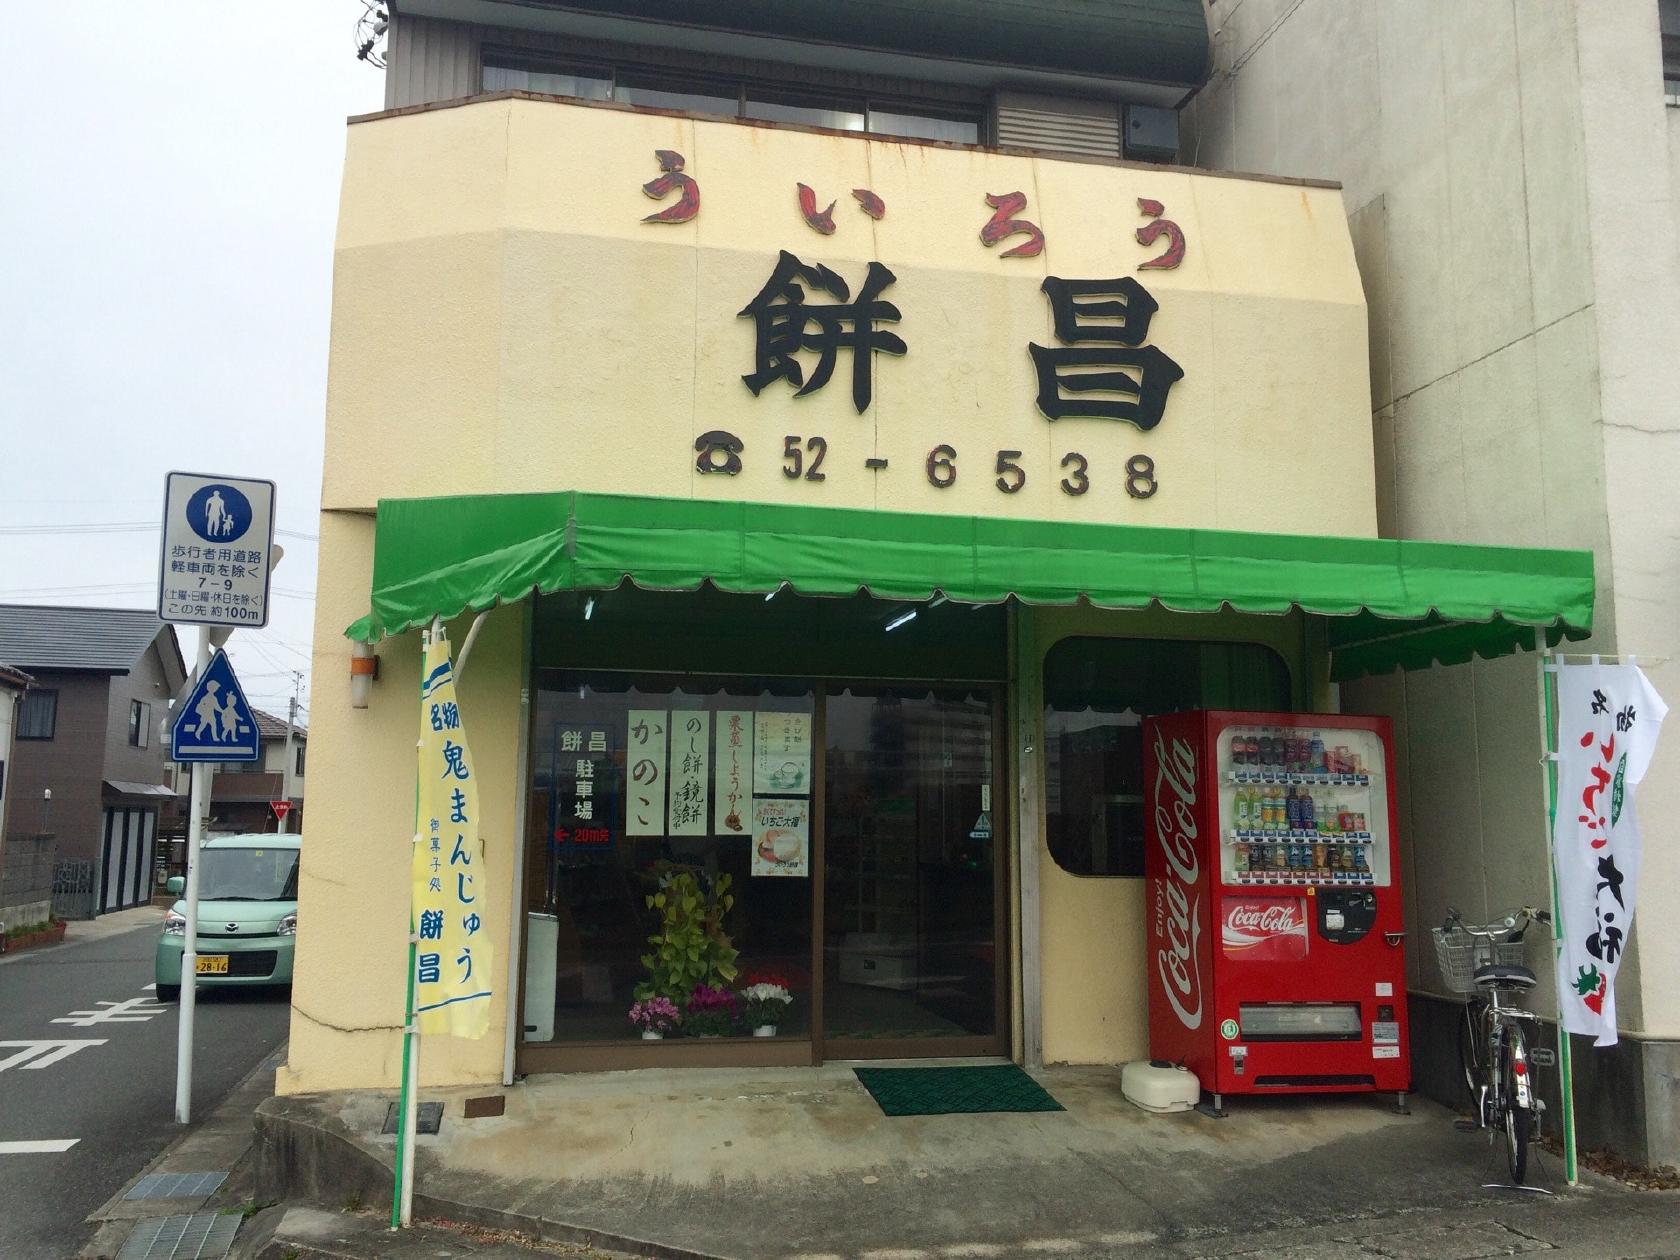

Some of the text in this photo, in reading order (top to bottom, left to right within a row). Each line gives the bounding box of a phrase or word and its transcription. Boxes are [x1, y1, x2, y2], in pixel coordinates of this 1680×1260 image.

[640, 149, 1186, 271] ういろう
[737, 249, 1184, 431] 餅昌
[171, 545, 262, 564] 歩行者用道路
[171, 560, 259, 578] 軽車両を除く
[168, 603, 259, 620] この先 約100m
[430, 702, 460, 731] 名物
[561, 730, 607, 752] 餅昌
[573, 759, 595, 820] 駐車場
[631, 719, 663, 826] かのこ
[761, 816, 801, 828] いちご大福
[441, 740, 481, 984] 鬼まんじゅう
[1155, 878, 1164, 938] Enjoy!
[1227, 905, 1296, 931] Coca-Cola
[417, 909, 444, 984] 餅昌
